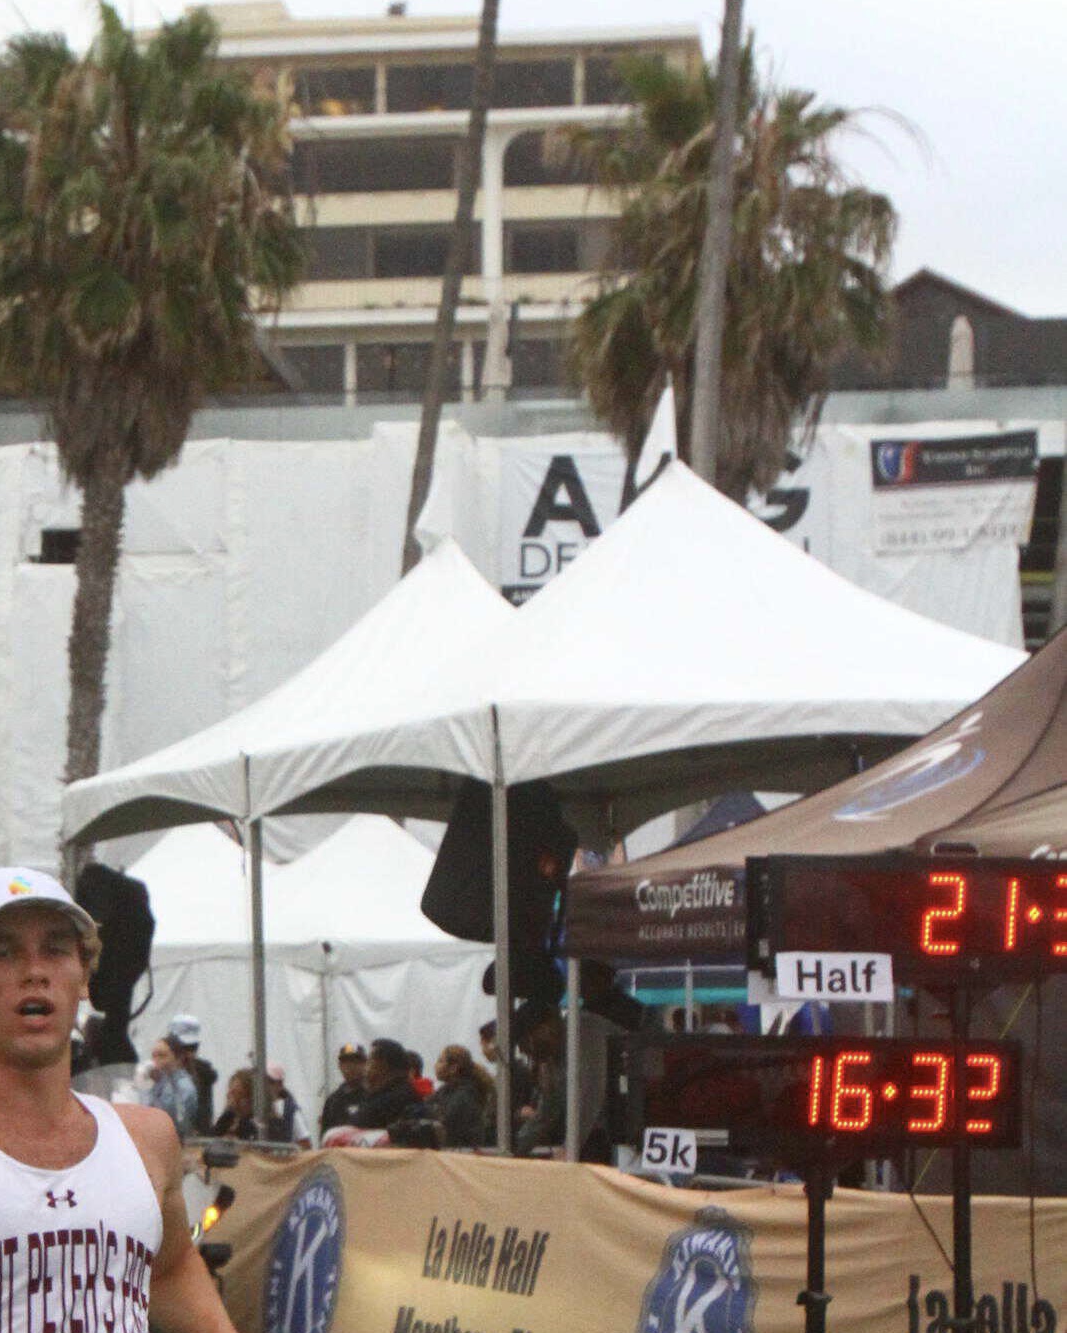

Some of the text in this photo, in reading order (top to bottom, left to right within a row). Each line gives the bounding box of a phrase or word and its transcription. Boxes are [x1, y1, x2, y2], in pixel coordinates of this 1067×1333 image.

[636, 872, 734, 918] Competitive
[795, 959, 877, 993] Half
[422, 1215, 550, 1298] La Jolla Half
